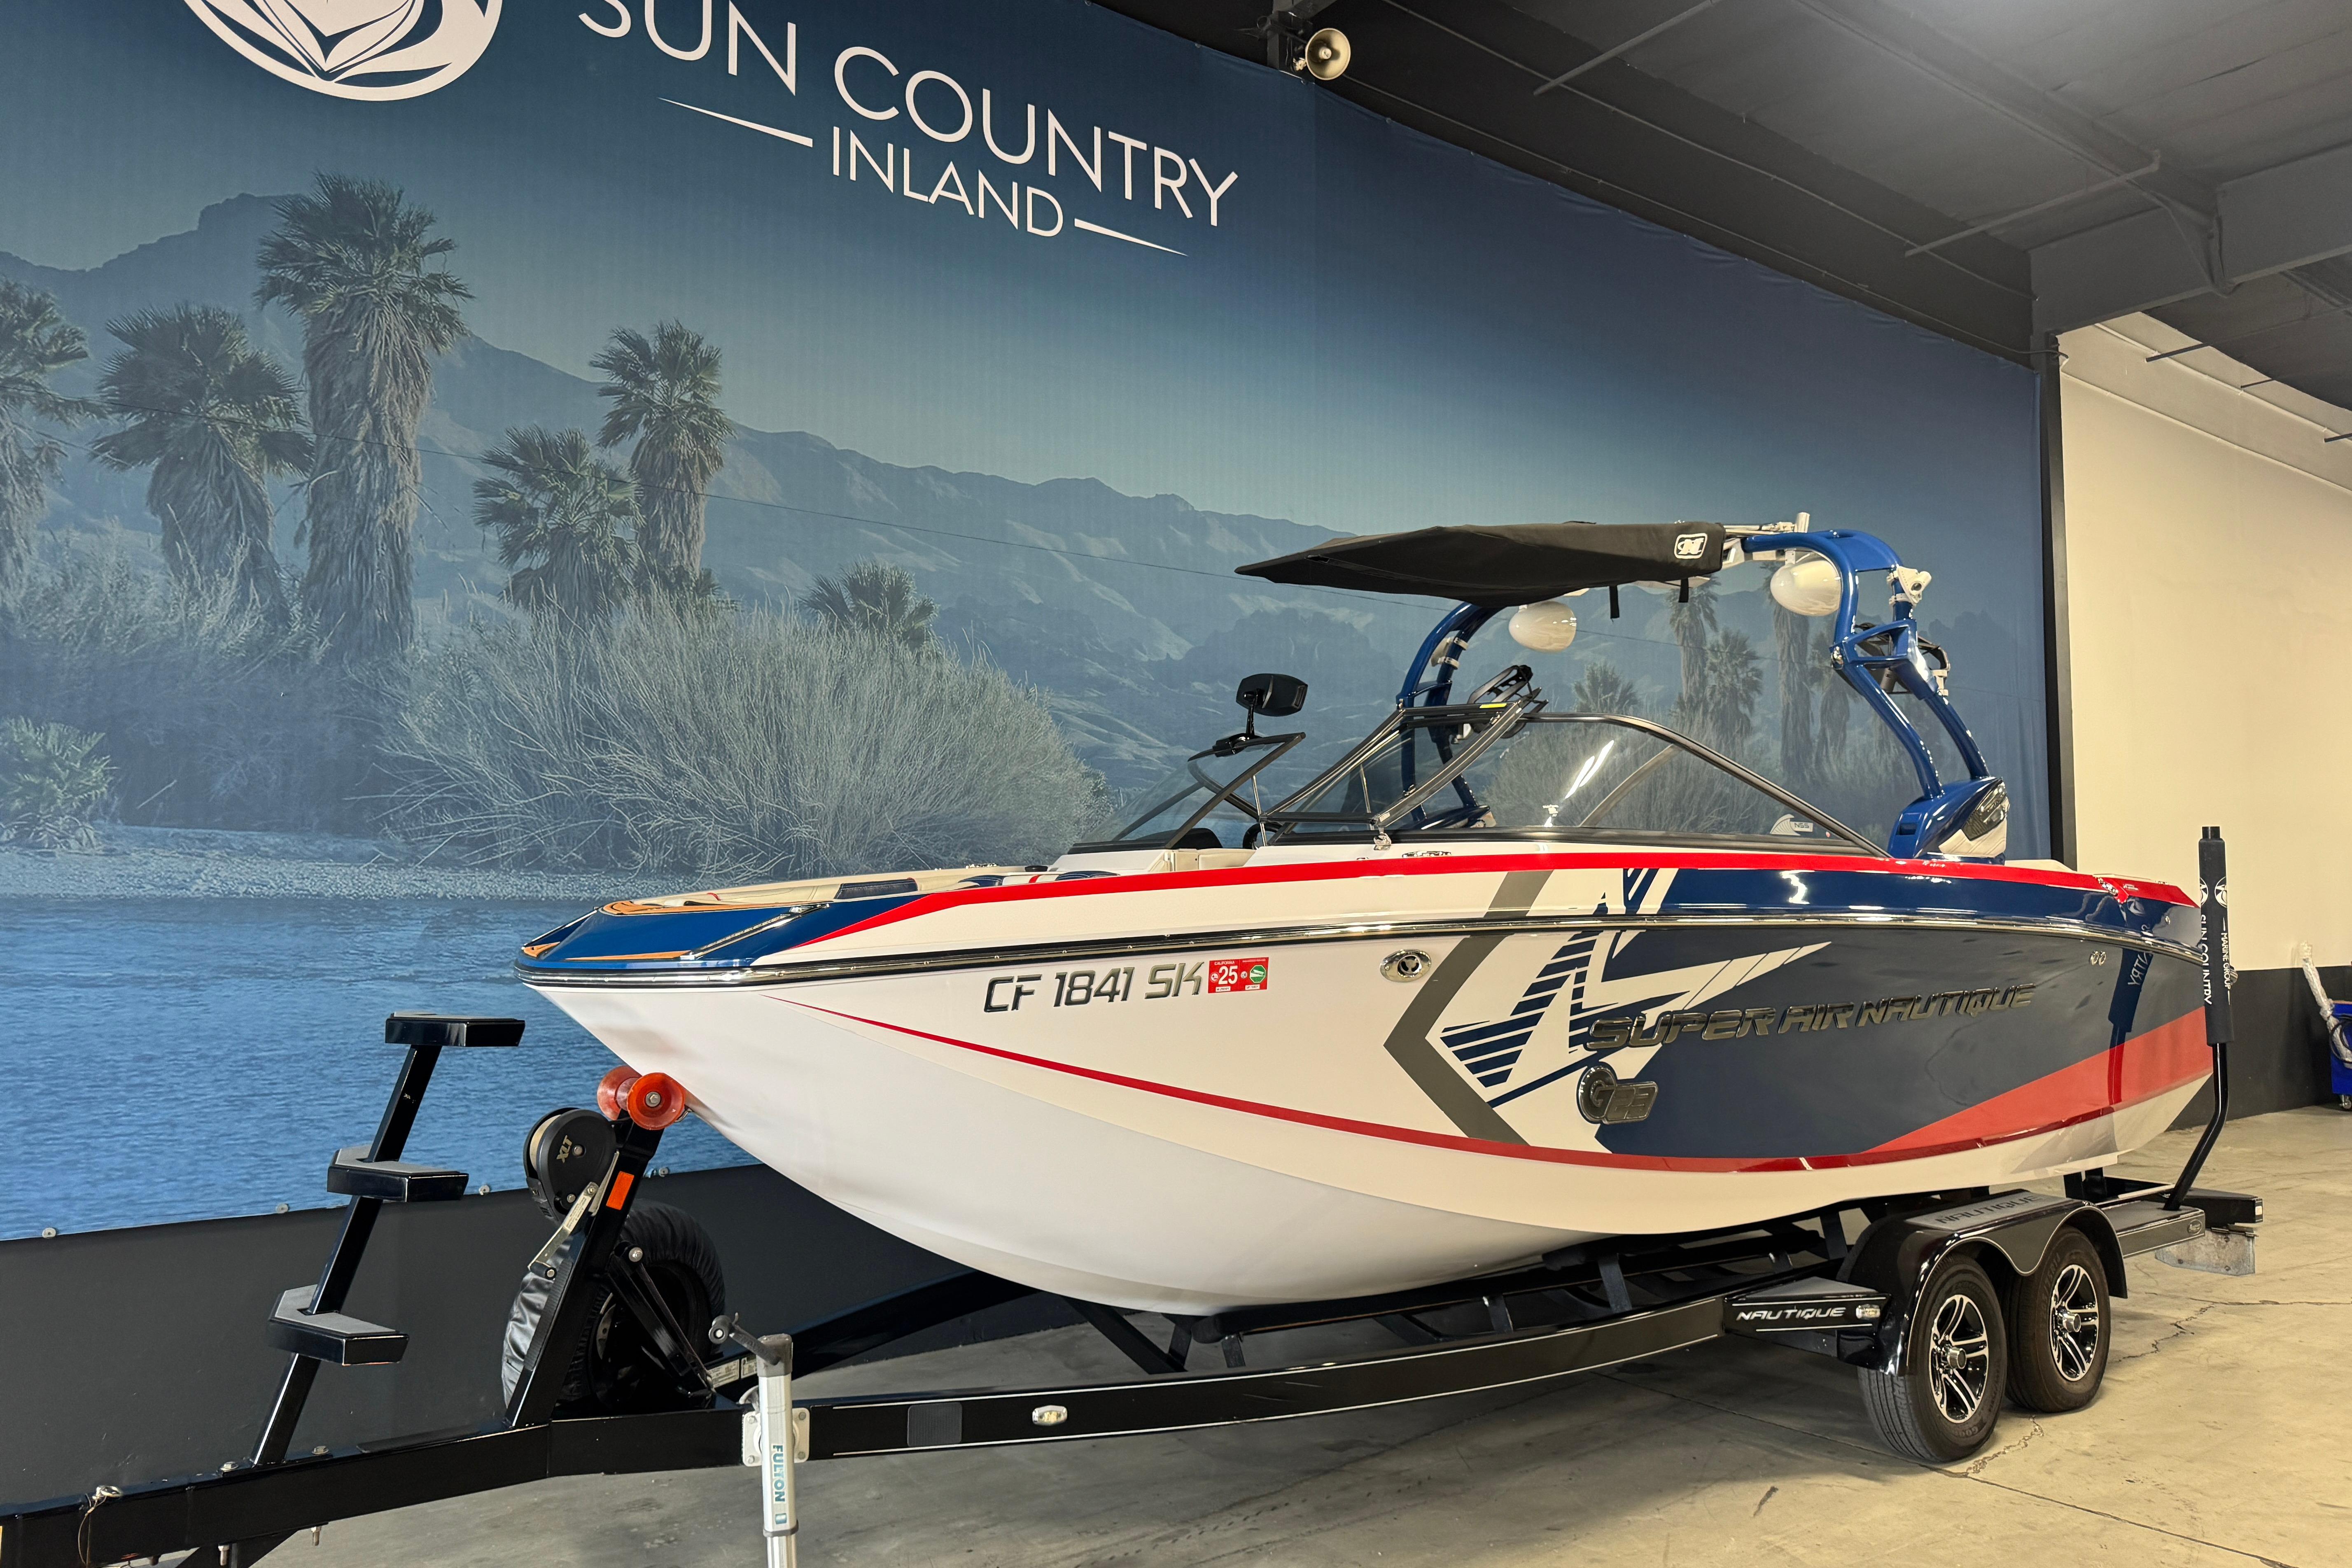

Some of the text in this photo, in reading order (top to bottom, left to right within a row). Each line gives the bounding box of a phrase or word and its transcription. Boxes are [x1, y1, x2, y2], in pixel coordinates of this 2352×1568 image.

[834, 47, 1238, 226] COUNTRY
[833, 126, 1063, 237] INLAND
[984, 961, 1205, 1013] CF 1841 SK
[1218, 965, 1238, 985] 25
[2221, 932, 2231, 989] MARINE GROUP
[1586, 982, 2036, 1049] SUPER AIR NAUTIQUE
[556, 1135, 572, 1163] XLT
[1935, 1195, 2039, 1224] NAUTIQUE
[1736, 1307, 1846, 1321] NAUTIQUE
[772, 1444, 786, 1502] FULTON
